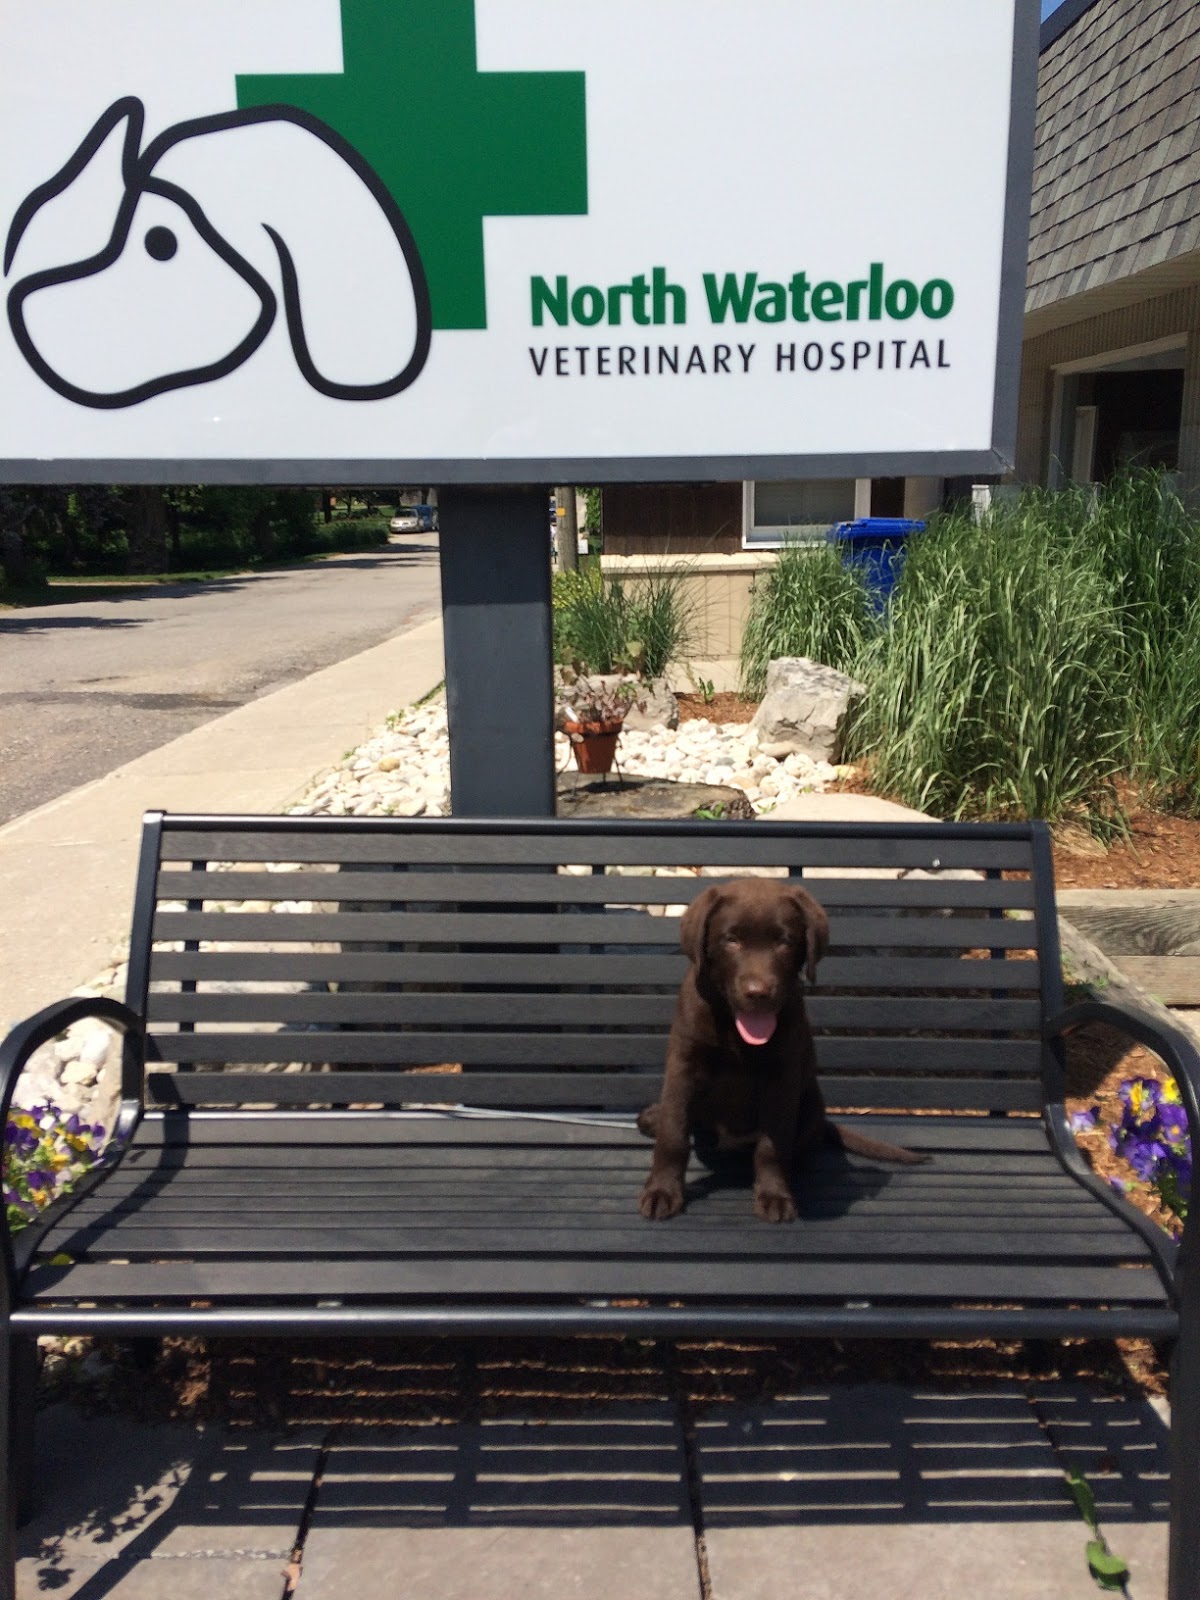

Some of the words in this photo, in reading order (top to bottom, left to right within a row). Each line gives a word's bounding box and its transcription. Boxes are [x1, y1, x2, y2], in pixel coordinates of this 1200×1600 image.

[531, 267, 686, 326] North
[703, 263, 954, 324] Waterloo
[529, 345, 755, 376] VETERINARY
[777, 340, 950, 371] HOSPITAL
